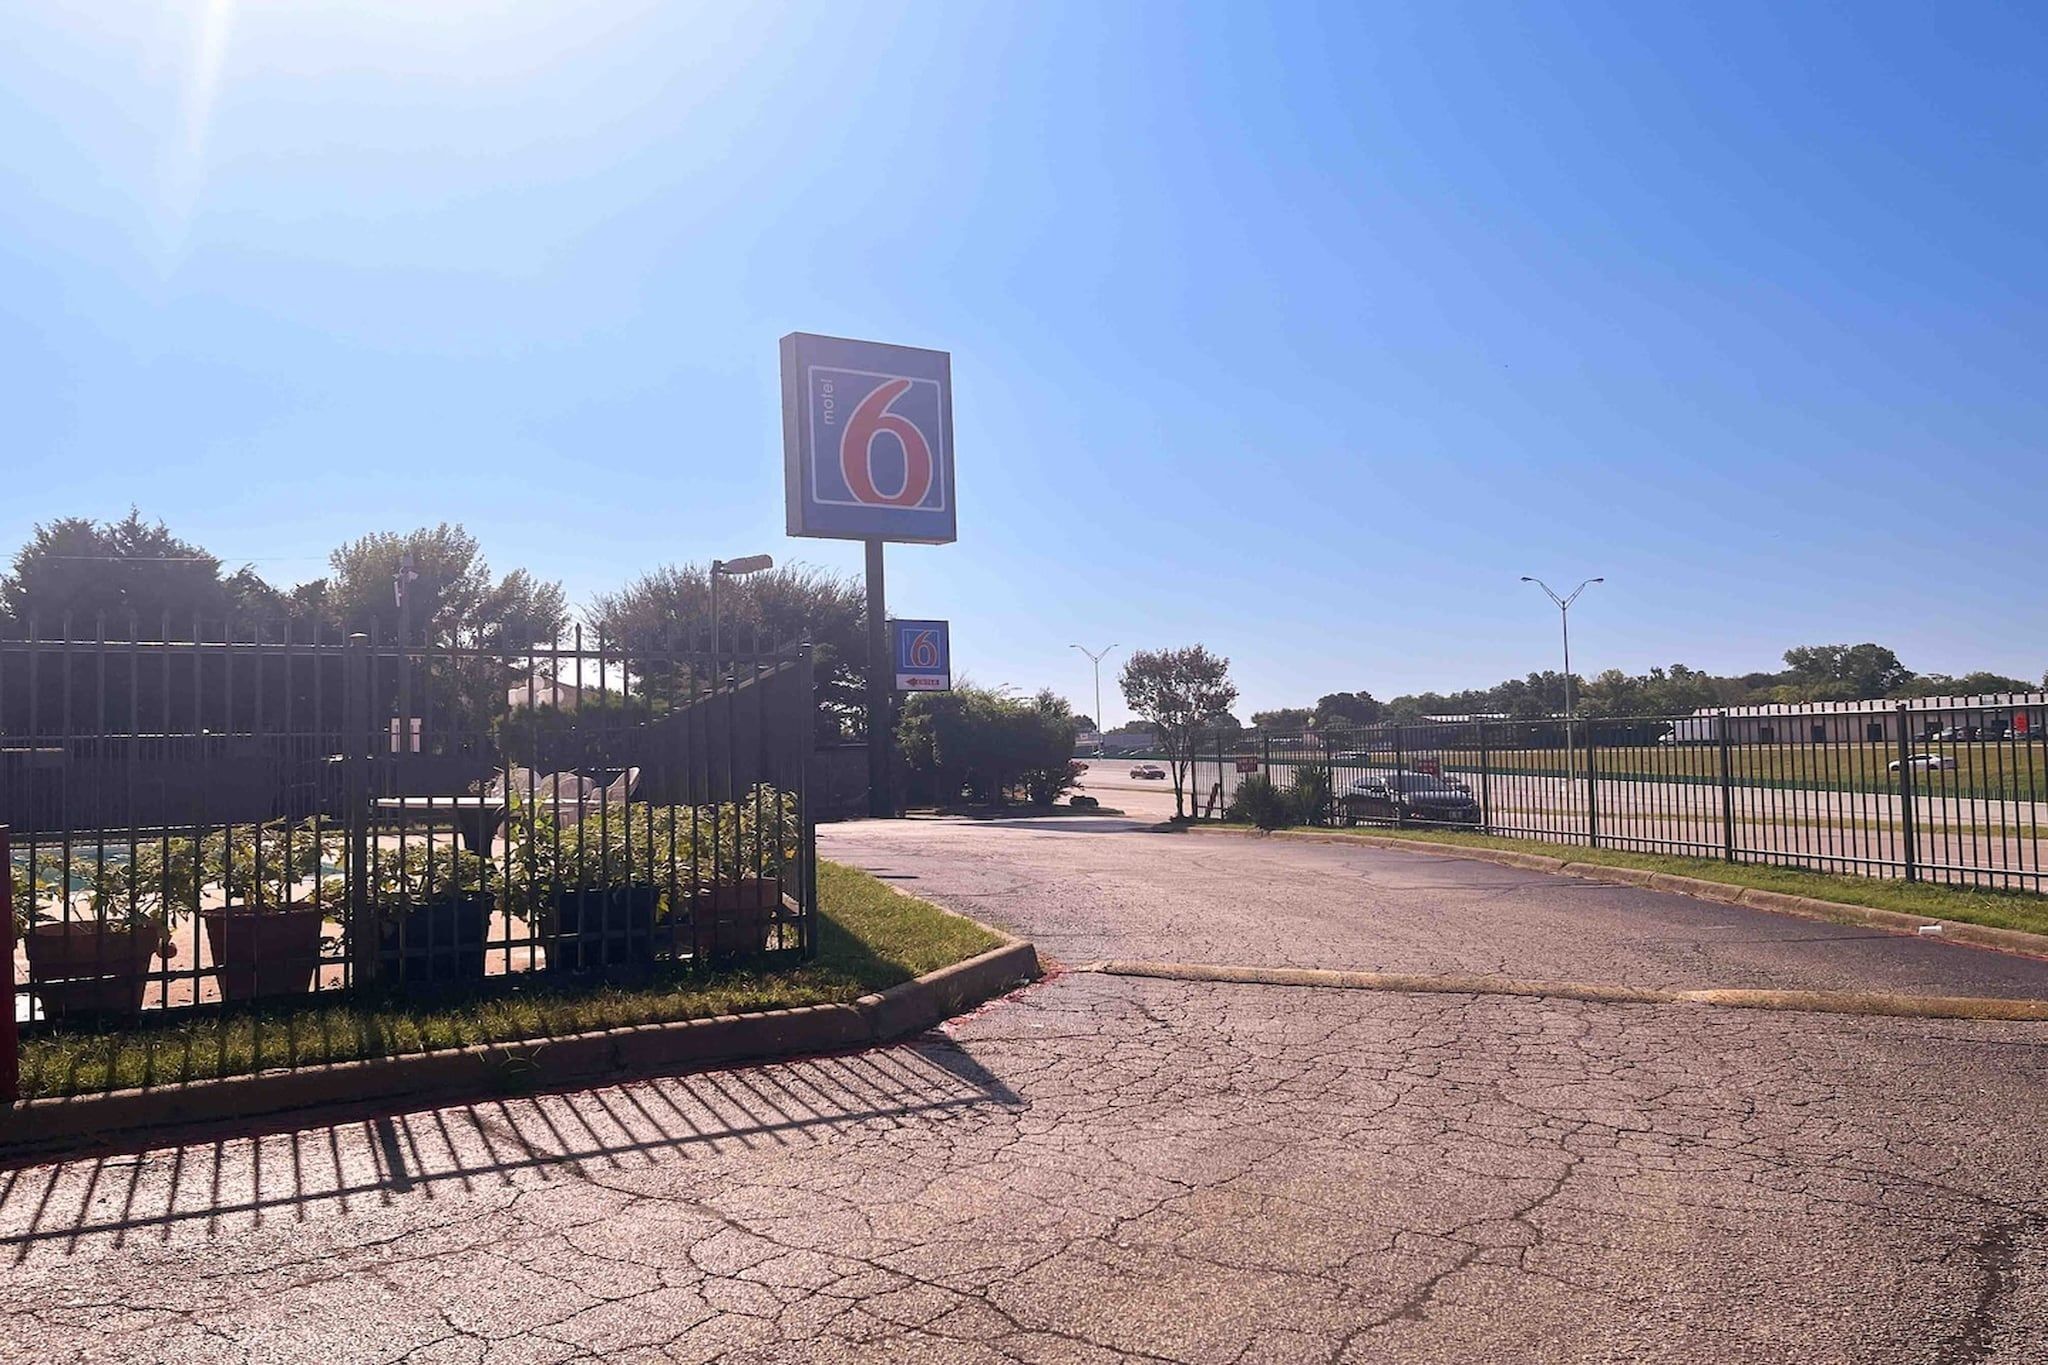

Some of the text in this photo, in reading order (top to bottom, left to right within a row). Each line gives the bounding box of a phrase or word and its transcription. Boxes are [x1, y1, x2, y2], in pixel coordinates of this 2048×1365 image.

[820, 378, 834, 425] motel
[840, 377, 933, 508] 6
[910, 629, 937, 668] 6
